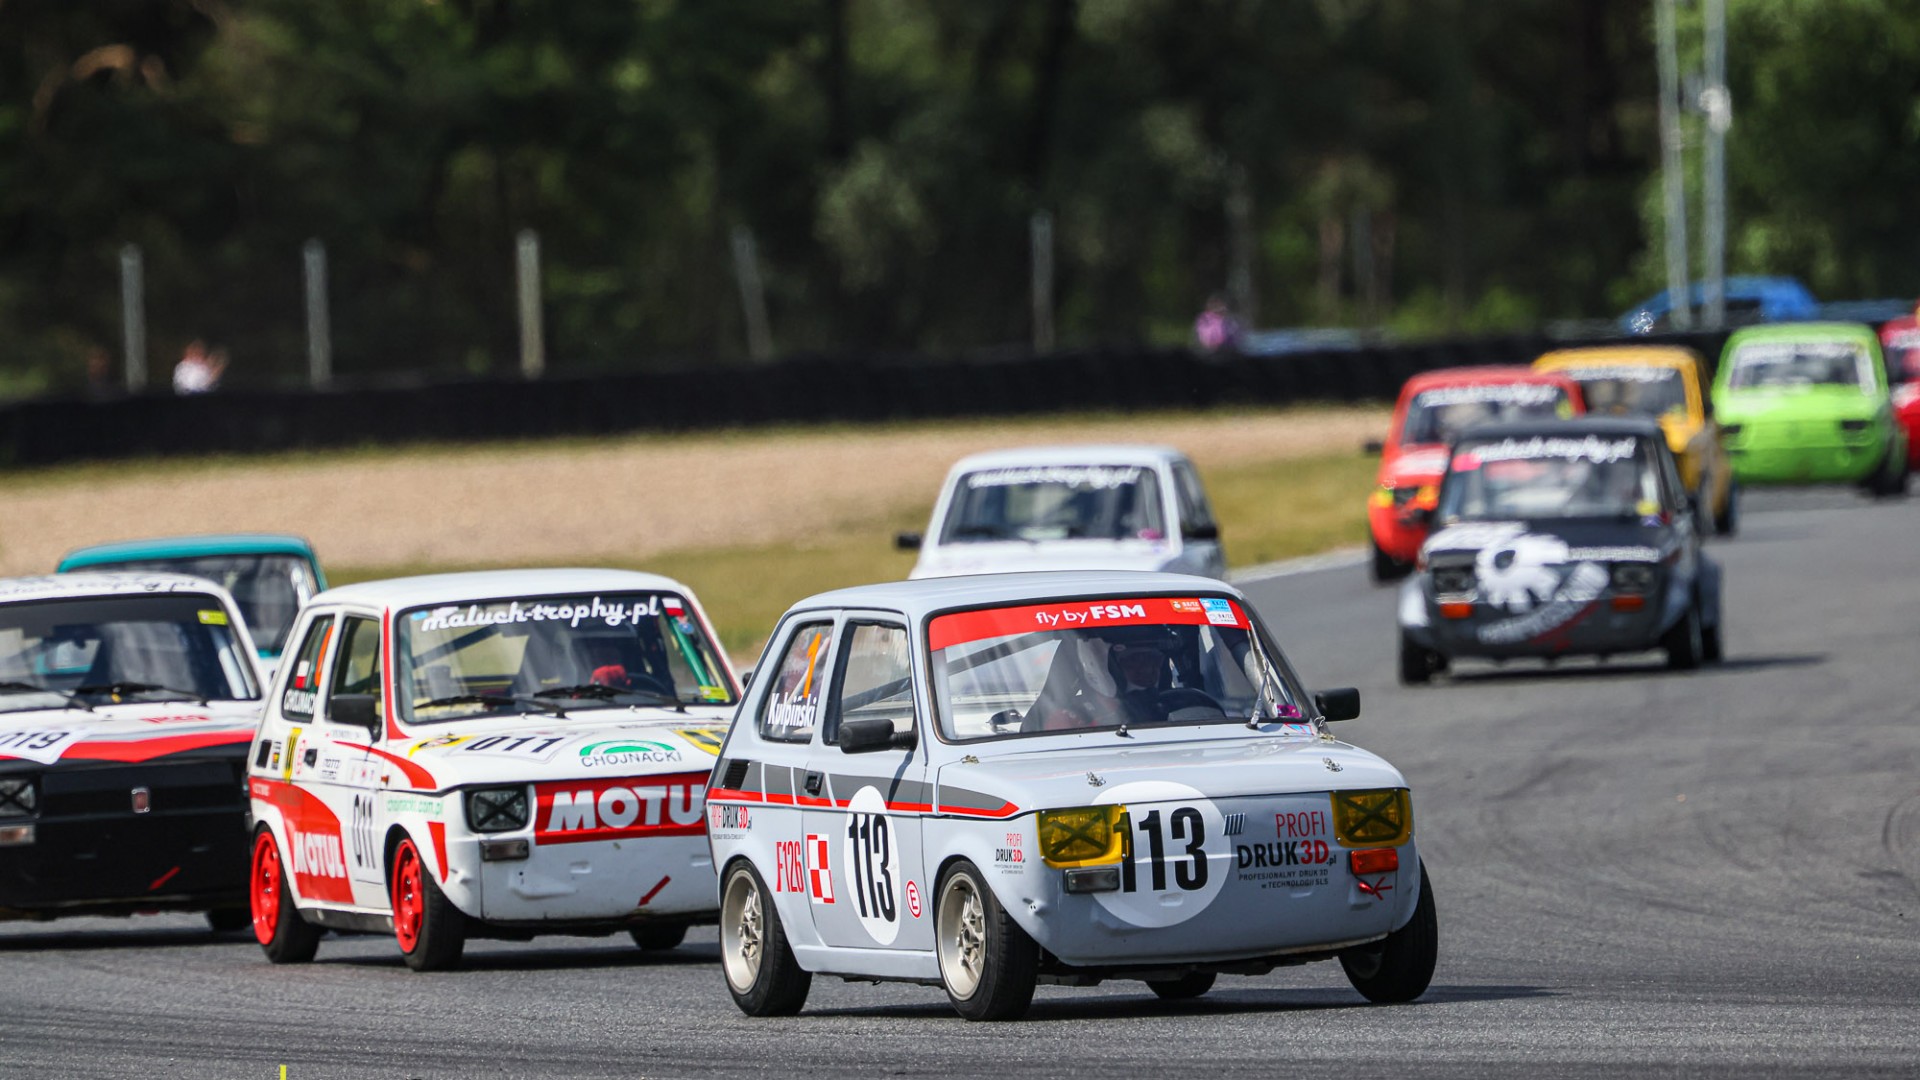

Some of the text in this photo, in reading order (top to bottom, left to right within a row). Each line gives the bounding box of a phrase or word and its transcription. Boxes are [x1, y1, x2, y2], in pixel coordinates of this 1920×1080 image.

[421, 595, 660, 631] maluch-trophy.pl
[1035, 604, 1146, 627] fly by FSM
[464, 735, 564, 754] 011
[581, 751, 682, 768] CHOJNACKI
[353, 793, 377, 869] 011
[1275, 811, 1326, 838] PROFI
[293, 832, 347, 878] MOTUL
[1112, 807, 1209, 893] 113
[1236, 840, 1337, 869] DRUK3D.pl
[776, 841, 804, 893] F126
[848, 813, 897, 923] 113
[1239, 871, 1296, 881] PROFESJONALNY
[1299, 869, 1318, 877] DRUK
[1316, 878, 1329, 886] SLS
